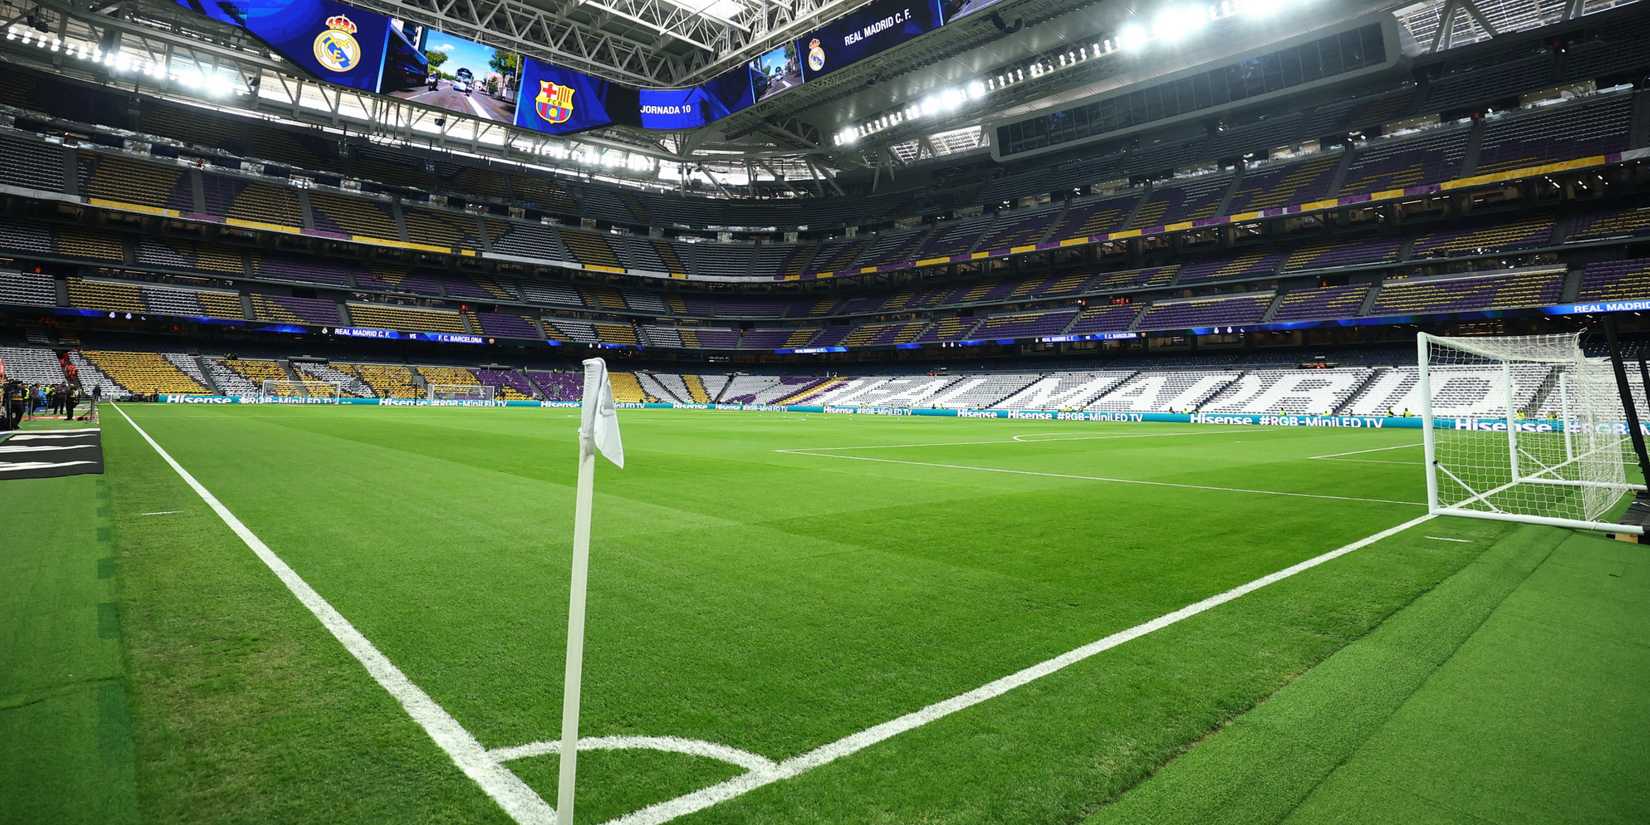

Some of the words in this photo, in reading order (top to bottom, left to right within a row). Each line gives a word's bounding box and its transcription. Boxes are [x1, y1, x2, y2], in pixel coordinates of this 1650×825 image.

[844, 30, 863, 46] REAL
[863, 16, 894, 38] MADRID
[895, 12, 904, 24] C.
[904, 8, 912, 20] F.
[640, 105, 680, 115] JORNADA
[682, 104, 692, 113] 10
[1574, 304, 1604, 313] REAL
[334, 328, 351, 336] REAL
[351, 329, 377, 337] MADRID
[450, 335, 482, 344] BARCELONA
[167, 394, 232, 403] Hisense
[379, 398, 428, 406] Hisense
[823, 406, 854, 414] Hisense
[904, 408, 912, 416] TV
[957, 408, 998, 418] Hisense
[1007, 410, 1052, 420] Hisense
[1057, 412, 1128, 422] #RGB-MiniLED
[1130, 414, 1143, 422] TV
[1190, 413, 1252, 424] Hisense
[1259, 415, 1362, 428] #RGB-MiniLED
[1365, 418, 1384, 428] TV
